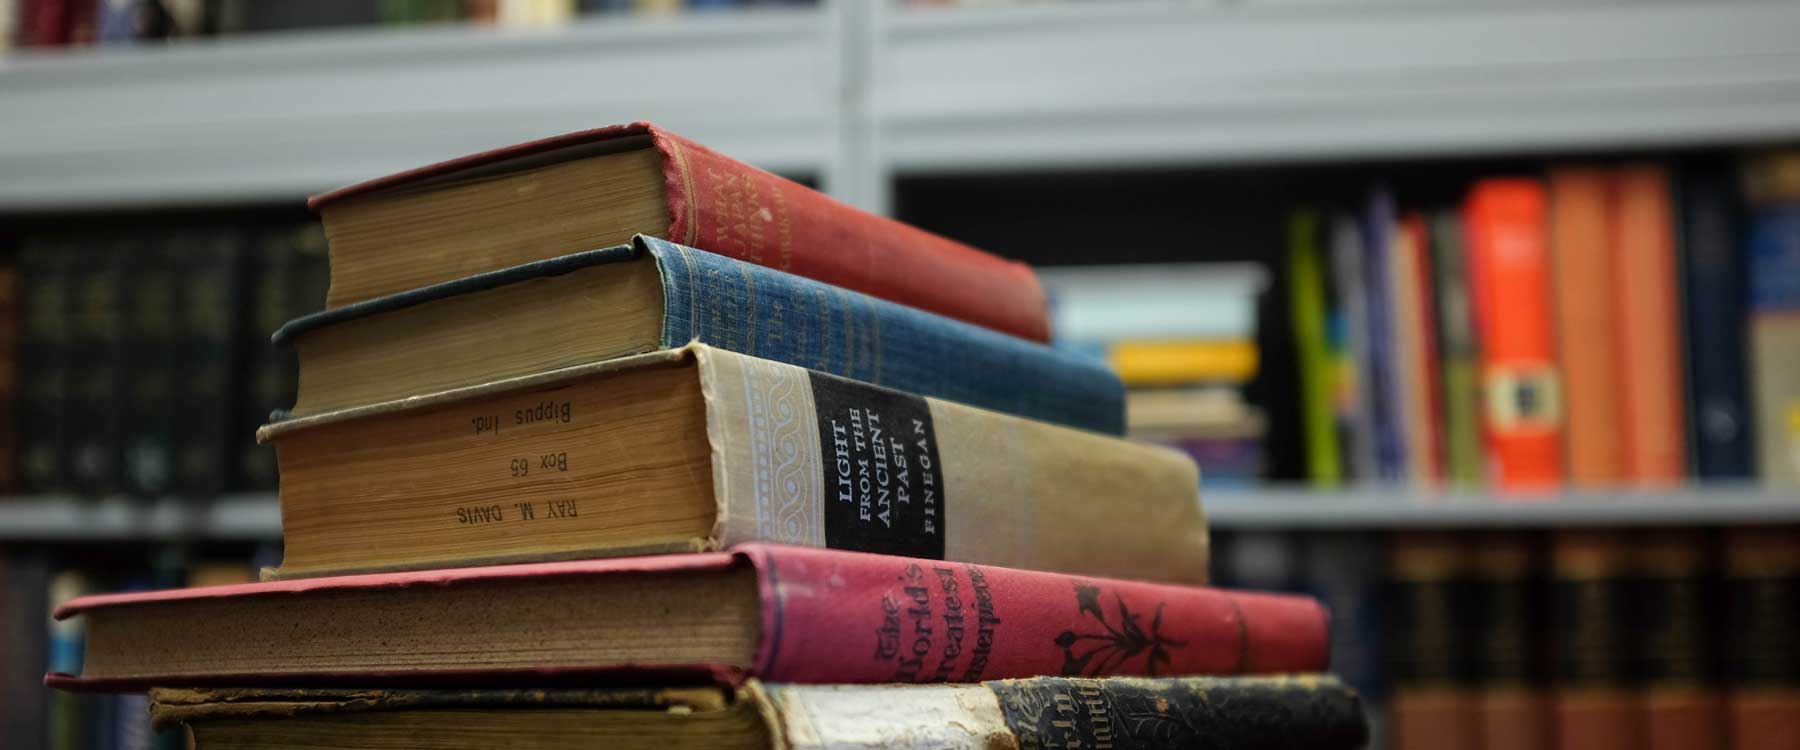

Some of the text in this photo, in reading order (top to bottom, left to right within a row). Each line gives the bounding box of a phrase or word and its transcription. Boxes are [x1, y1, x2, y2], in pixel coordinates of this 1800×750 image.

[724, 170, 746, 256] JAPAN
[472, 401, 571, 435] Bippus Ind.
[510, 452, 567, 477] Box 65
[832, 420, 853, 502] LIGHT
[849, 408, 871, 522] FROM THE
[865, 408, 890, 528] ANCIENT
[890, 437, 910, 504] PAST
[913, 419, 935, 534] FINEGAN
[457, 500, 578, 524] RAY M. DAVIS
[875, 591, 900, 661] The
[933, 567, 964, 682] reatest
